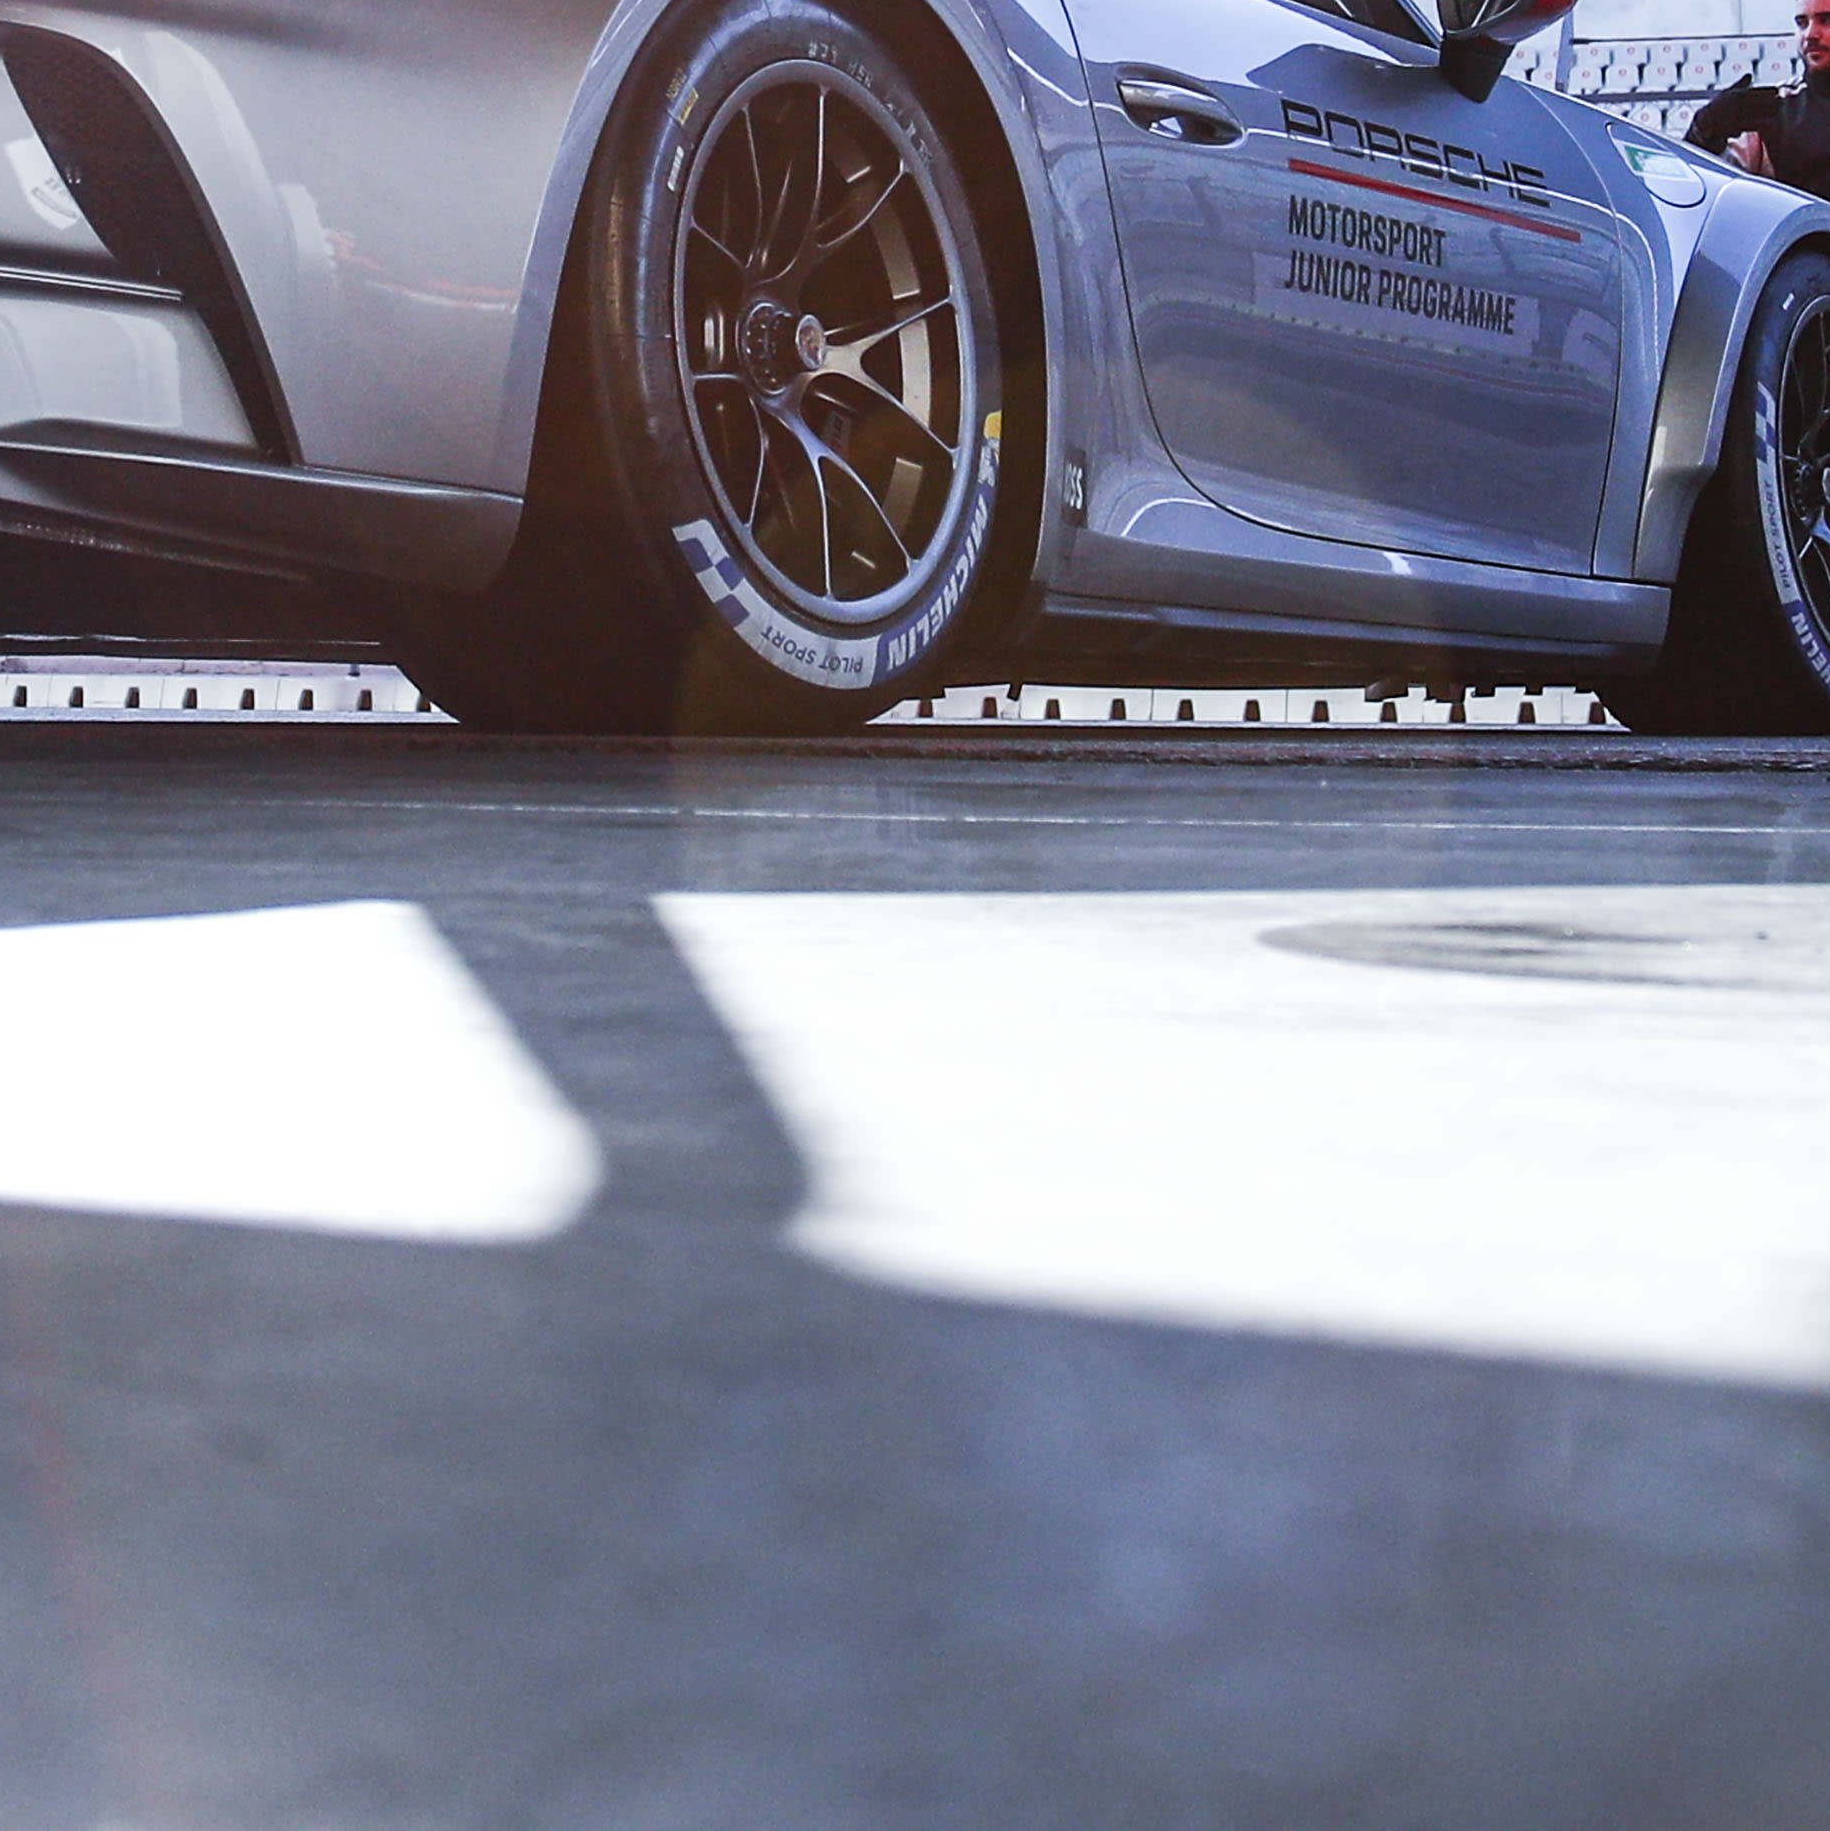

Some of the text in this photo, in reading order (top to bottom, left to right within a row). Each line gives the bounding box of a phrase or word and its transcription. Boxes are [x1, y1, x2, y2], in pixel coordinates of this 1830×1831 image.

[1280, 98, 1551, 209] PORSCHE
[1288, 194, 1447, 268] MOTORSPORT
[1284, 249, 1517, 336] JUNIOR PROGRAMME
[886, 493, 990, 672] MICHELIN
[761, 625, 865, 674] PILOT SPORT
